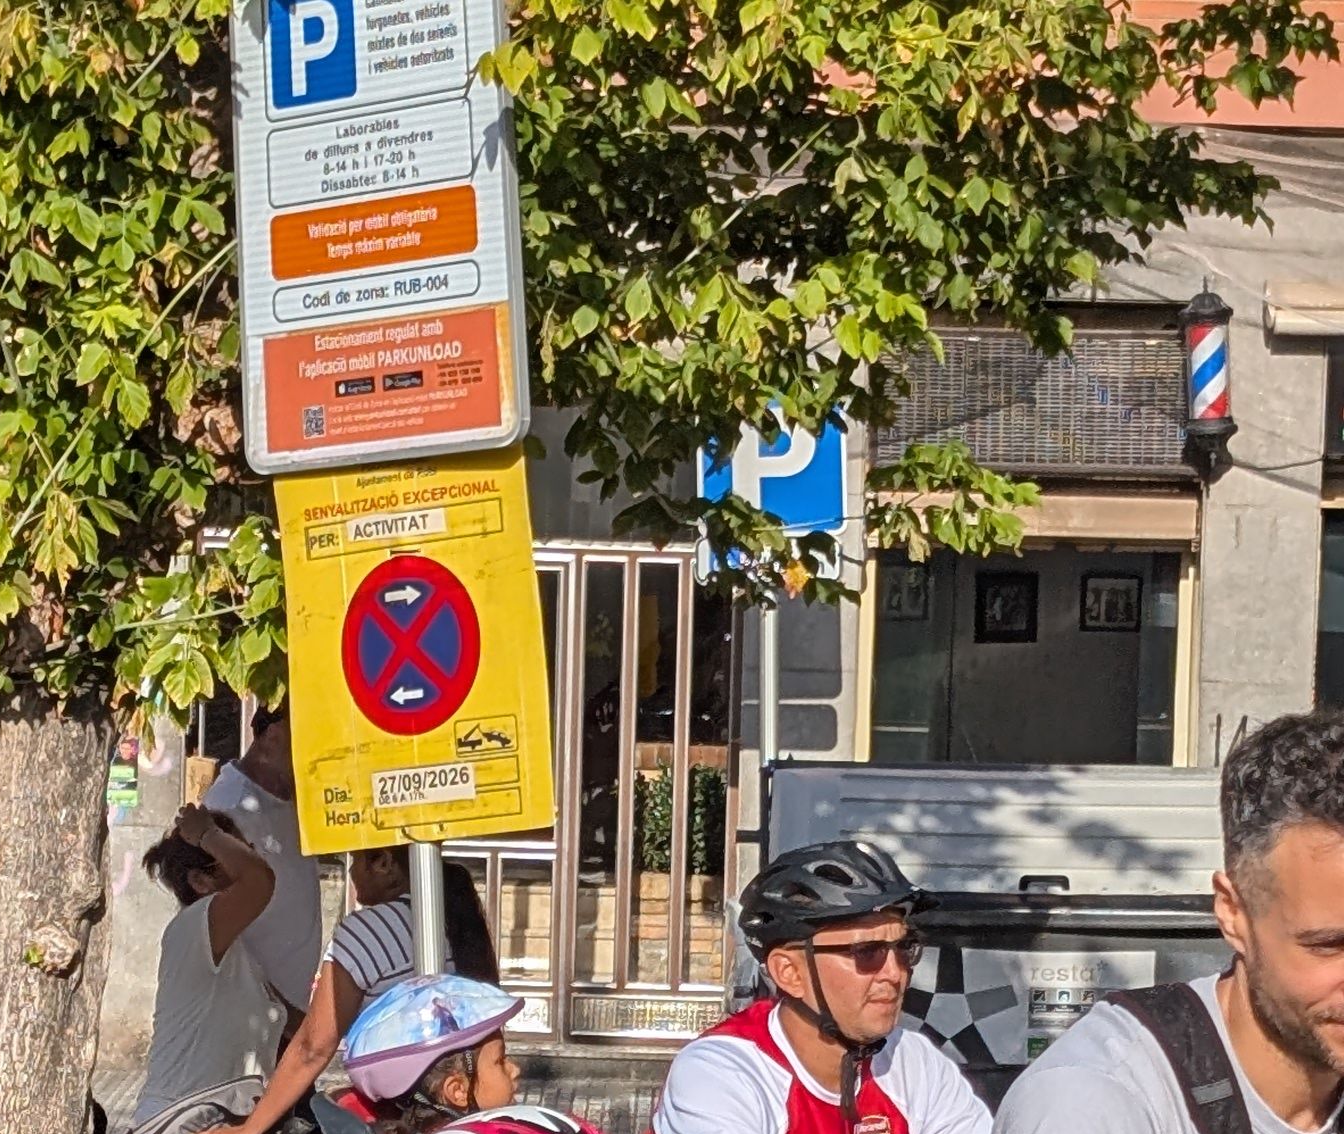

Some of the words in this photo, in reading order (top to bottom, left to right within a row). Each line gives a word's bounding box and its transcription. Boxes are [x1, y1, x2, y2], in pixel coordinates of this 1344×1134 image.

[335, 118, 400, 139] Laborables
[304, 148, 318, 162] de
[323, 142, 360, 158] dilluns
[377, 129, 434, 149] divendres
[302, 291, 331, 310] Codi
[335, 287, 351, 305] de
[394, 273, 450, 298] RUB-004
[377, 340, 463, 368] PARKUNLOAD
[304, 490, 399, 522] SENYALITZACIÓ
[403, 479, 500, 505] EXCEPCIONAL
[309, 530, 340, 551] PER:
[353, 513, 429, 541] ACTIVITAT
[378, 766, 470, 795] 27/09/2026
[1030, 963, 1096, 983] resta
